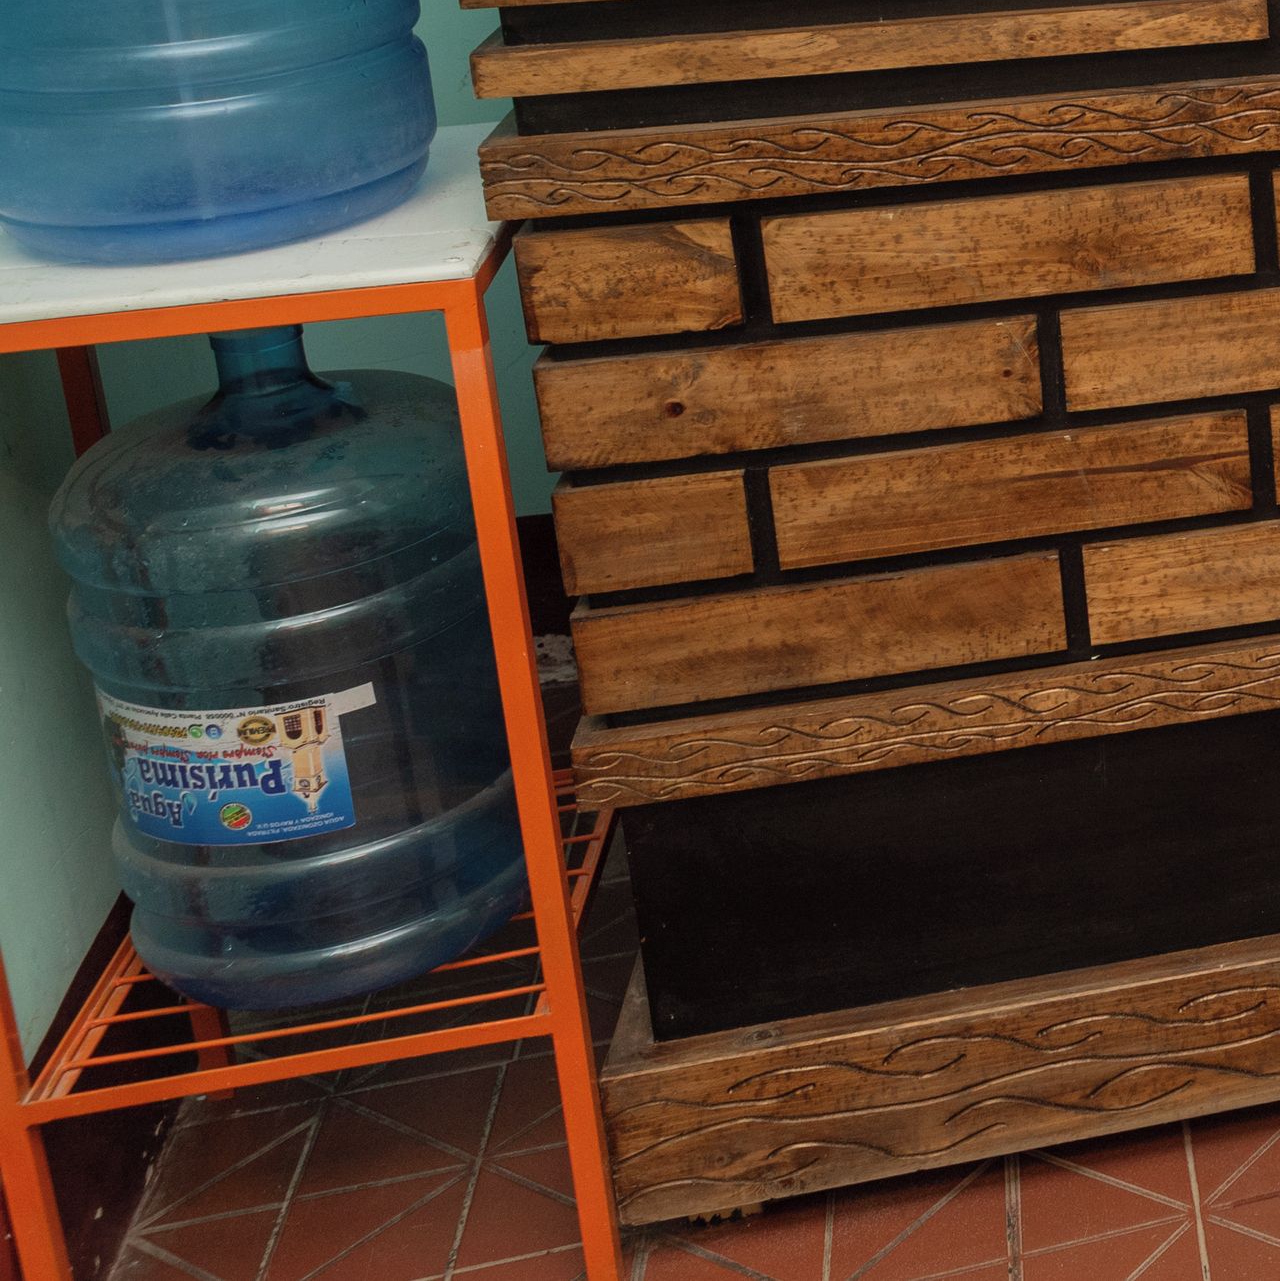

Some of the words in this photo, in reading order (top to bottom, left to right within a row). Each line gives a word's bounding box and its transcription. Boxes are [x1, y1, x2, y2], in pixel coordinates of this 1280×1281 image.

[288, 698, 326, 710] Registro
[248, 707, 286, 715] Sanitario
[237, 725, 276, 736] PREMIUM
[151, 742, 193, 763] Siempre
[222, 743, 277, 759] Siempre
[137, 757, 287, 802] Purísima
[129, 790, 184, 827] Agua
[300, 812, 334, 823] IONIZADA
[323, 815, 345, 823] AGUA
[269, 820, 294, 828] RAYOS
